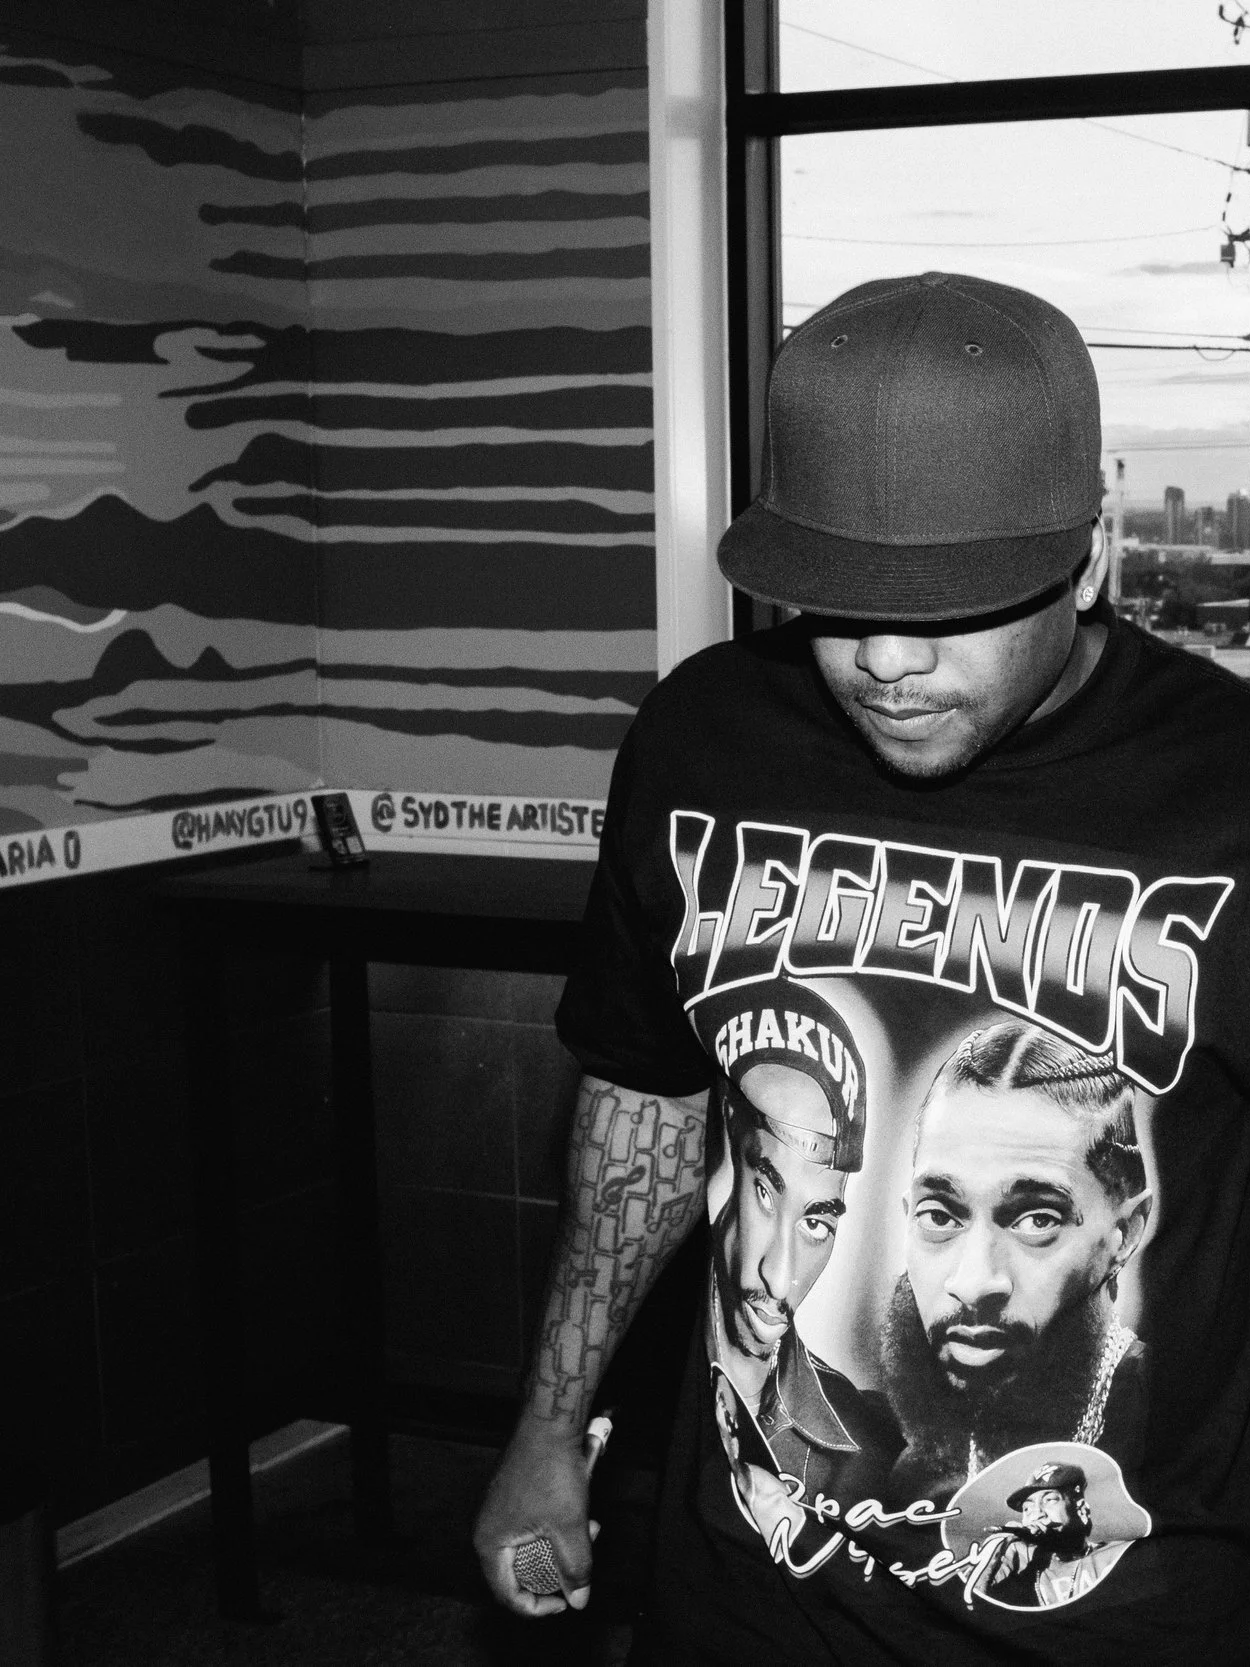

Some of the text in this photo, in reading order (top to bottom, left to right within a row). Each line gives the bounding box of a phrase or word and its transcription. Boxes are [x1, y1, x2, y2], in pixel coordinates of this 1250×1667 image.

[669, 809, 1236, 1095] LEGENDS
[777, 1471, 962, 1532] 2pac
[768, 1515, 1010, 1611] Nsey
